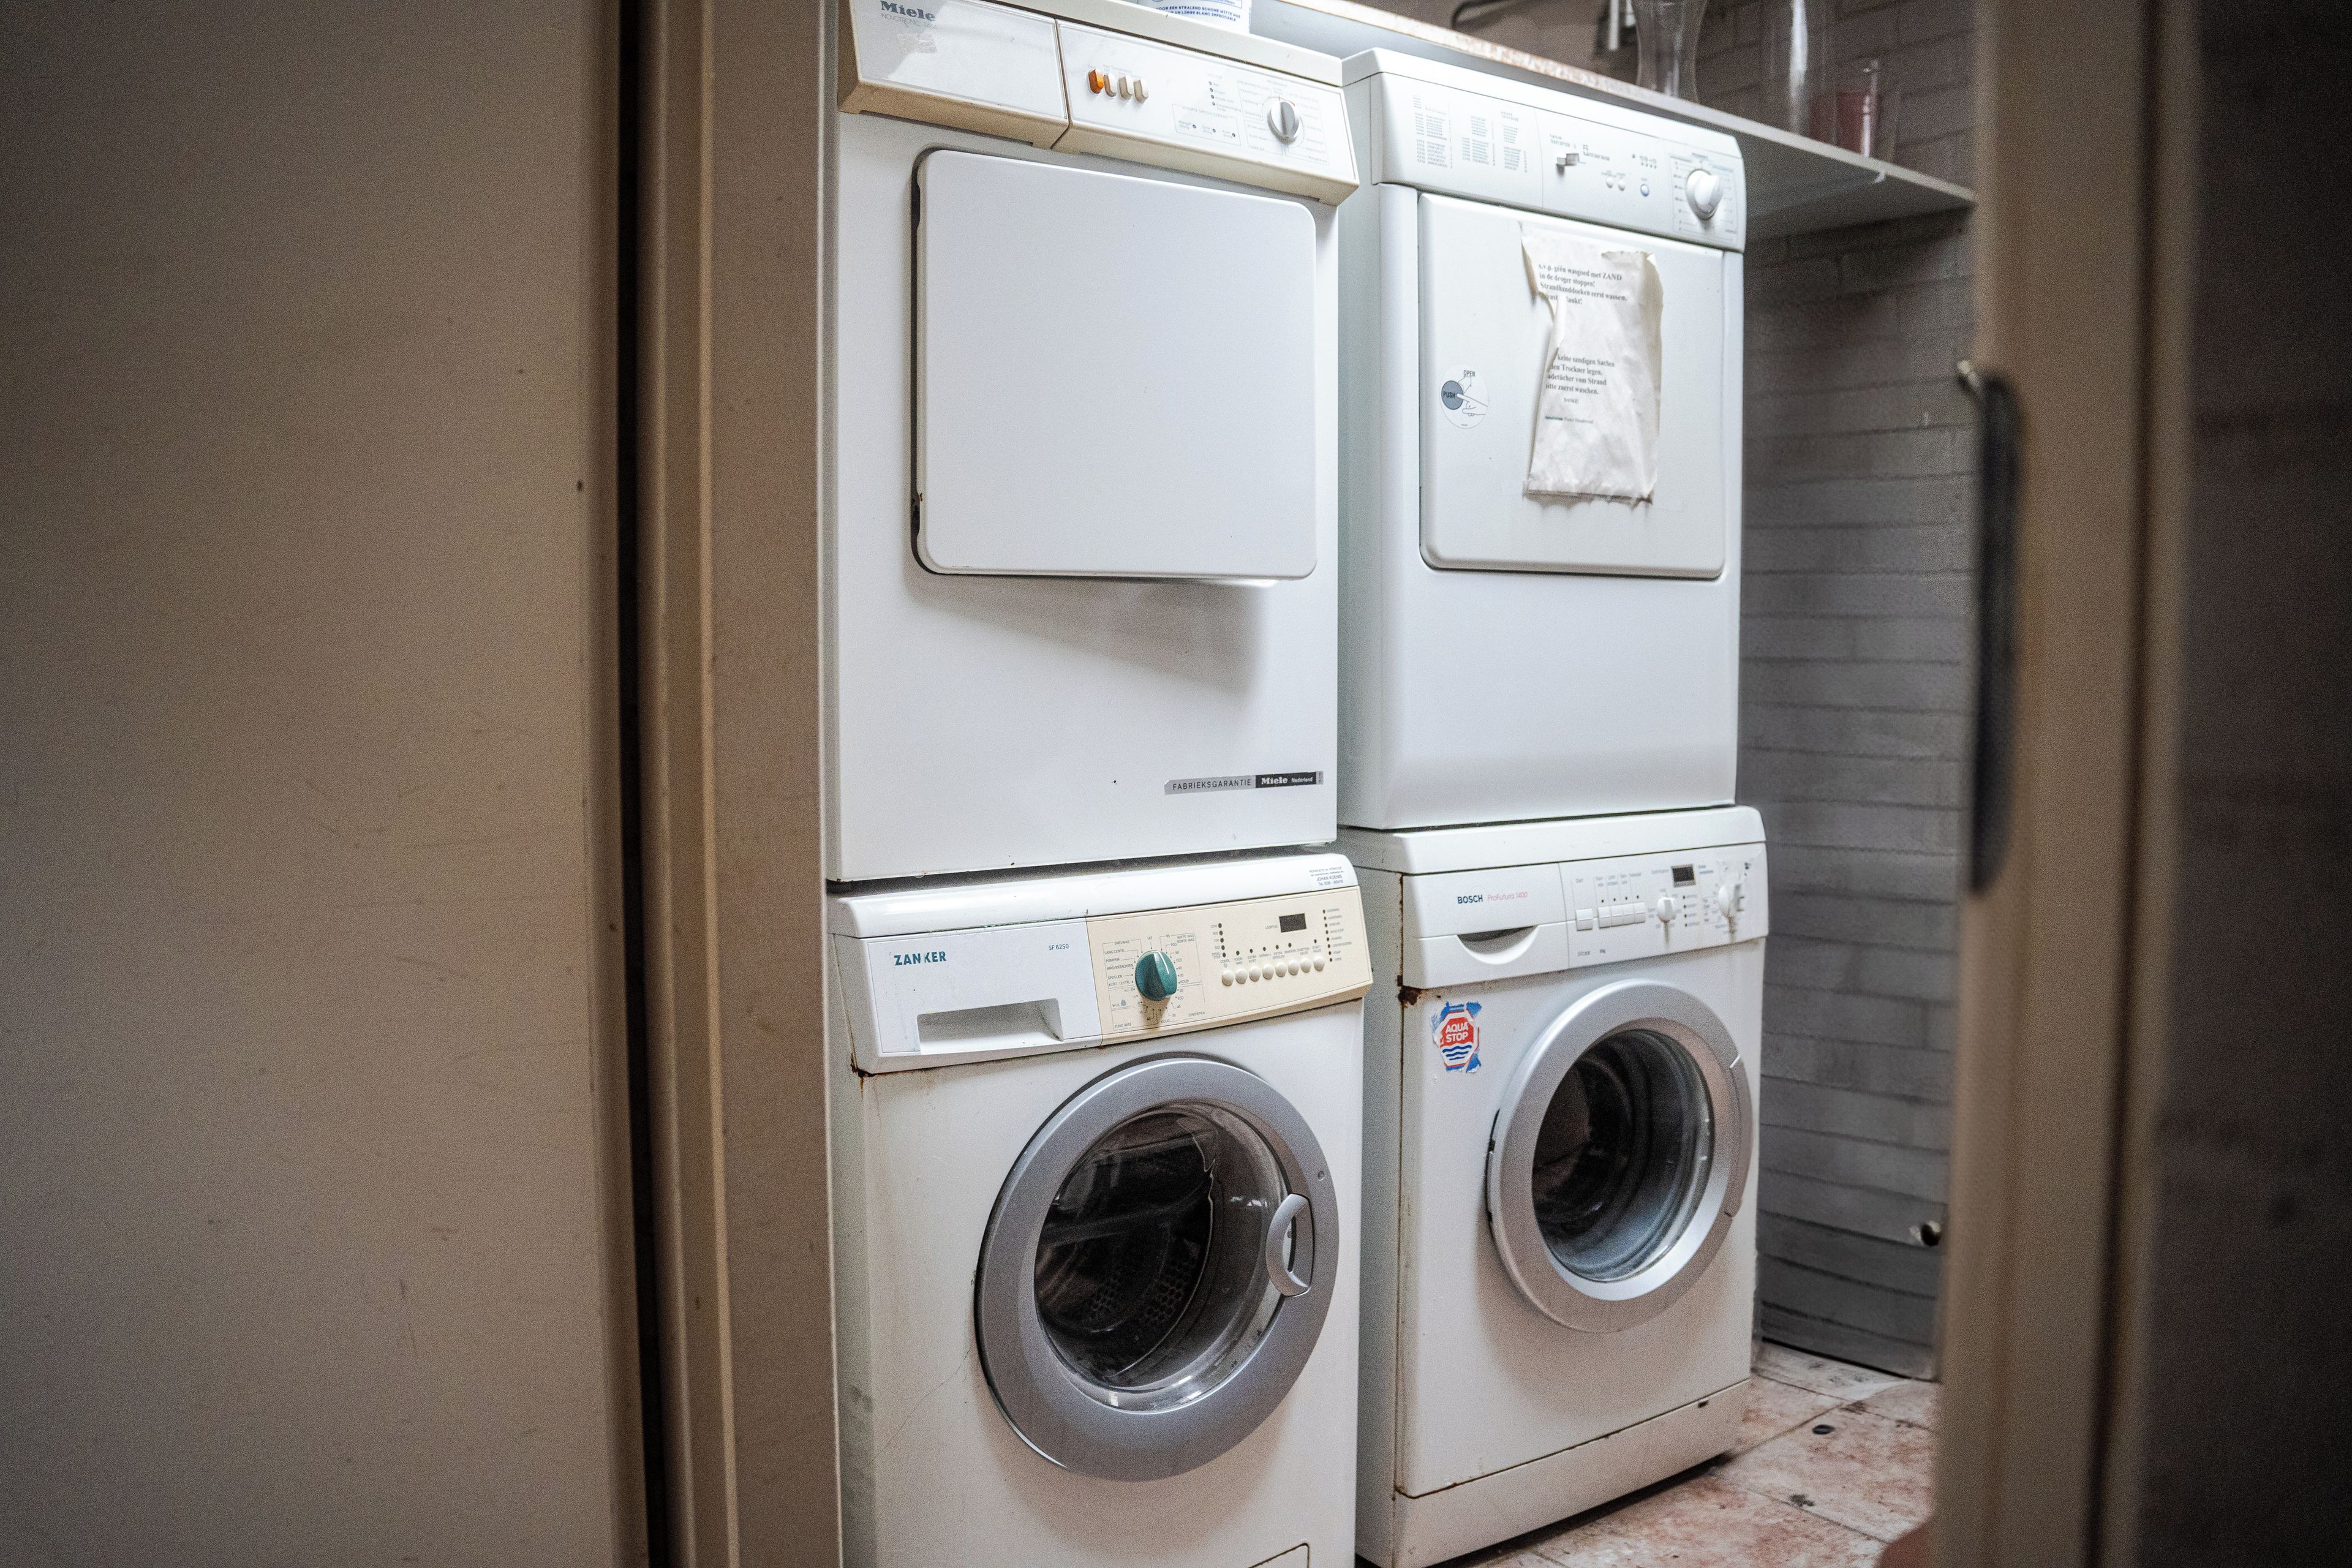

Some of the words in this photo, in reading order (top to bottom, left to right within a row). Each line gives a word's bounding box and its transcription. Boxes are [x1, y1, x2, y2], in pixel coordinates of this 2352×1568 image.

[880, 1, 936, 21] Miele
[1212, 13, 1236, 21] IMPECCABLE
[881, 13, 921, 26] NOVOTRONIC
[1554, 275, 1571, 284] droger
[1573, 279, 1595, 287] stoppen!
[1540, 282, 1590, 296] Strandhanddoeken
[1561, 364, 1585, 374] Trockner
[1172, 778, 1251, 791] FABRIEKSGARANTIE
[1261, 776, 1288, 785] Miele
[1457, 894, 1483, 904] BOSCH
[894, 951, 947, 966] ZANKER
[1446, 1022, 1469, 1033] AQUA
[1446, 1032, 1469, 1042] STOP
